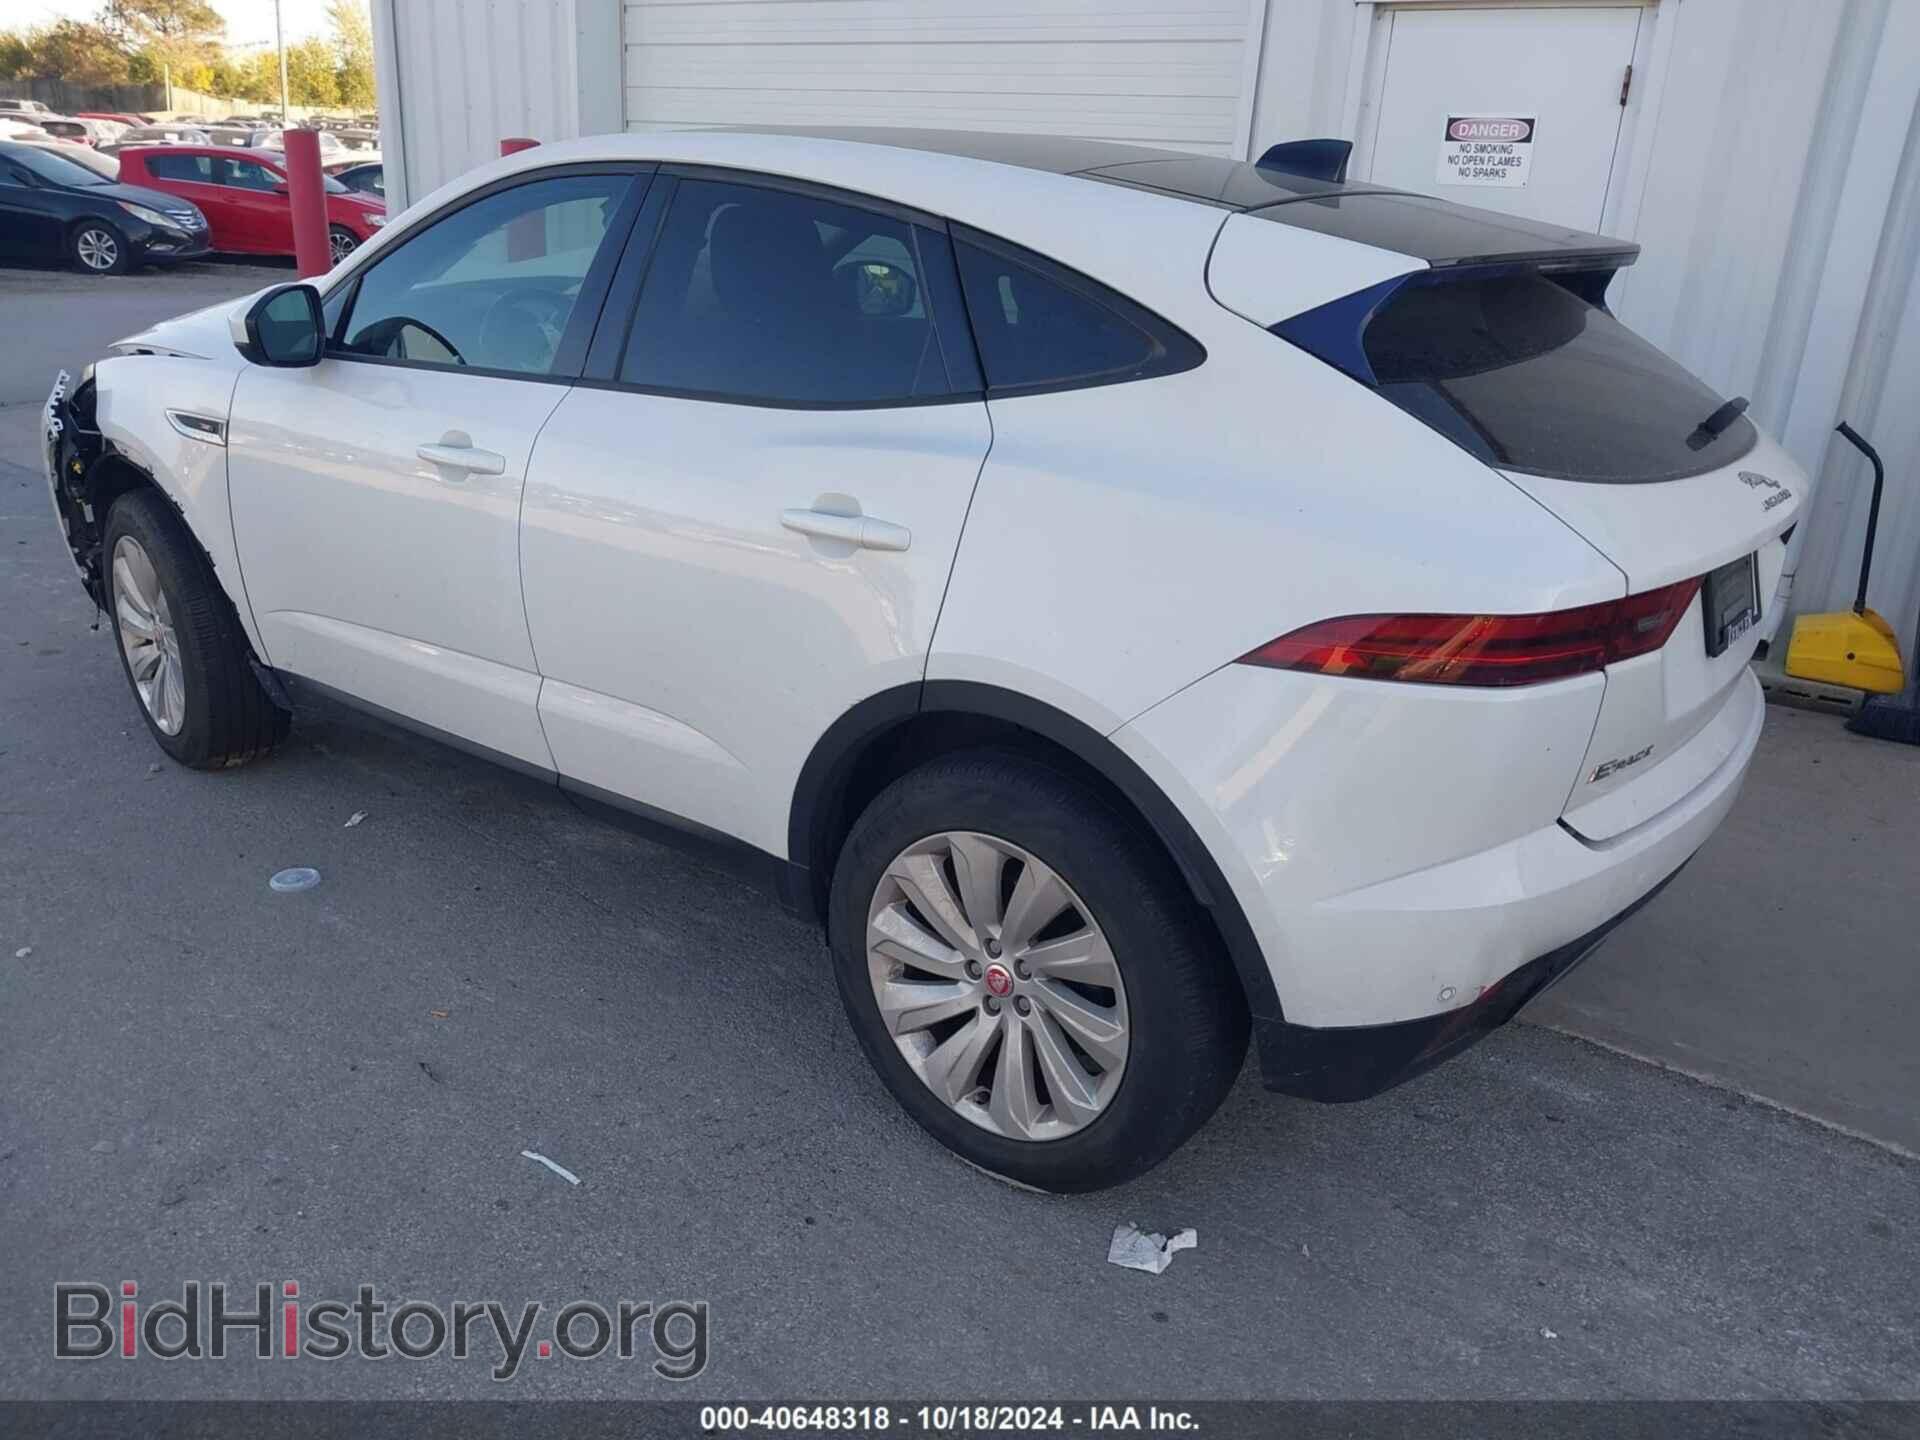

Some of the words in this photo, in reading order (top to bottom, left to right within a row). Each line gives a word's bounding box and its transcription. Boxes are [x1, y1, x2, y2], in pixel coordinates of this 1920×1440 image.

[1458, 123, 1520, 137] DANGER
[1459, 143, 1472, 154] NO
[1473, 143, 1514, 155] SMOKING
[1447, 154, 1460, 166] NO
[1461, 155, 1486, 166] OPEN
[1486, 155, 1522, 168] FLAMES
[1458, 167, 1471, 178] NO
[1472, 167, 1508, 179] SPARKS
